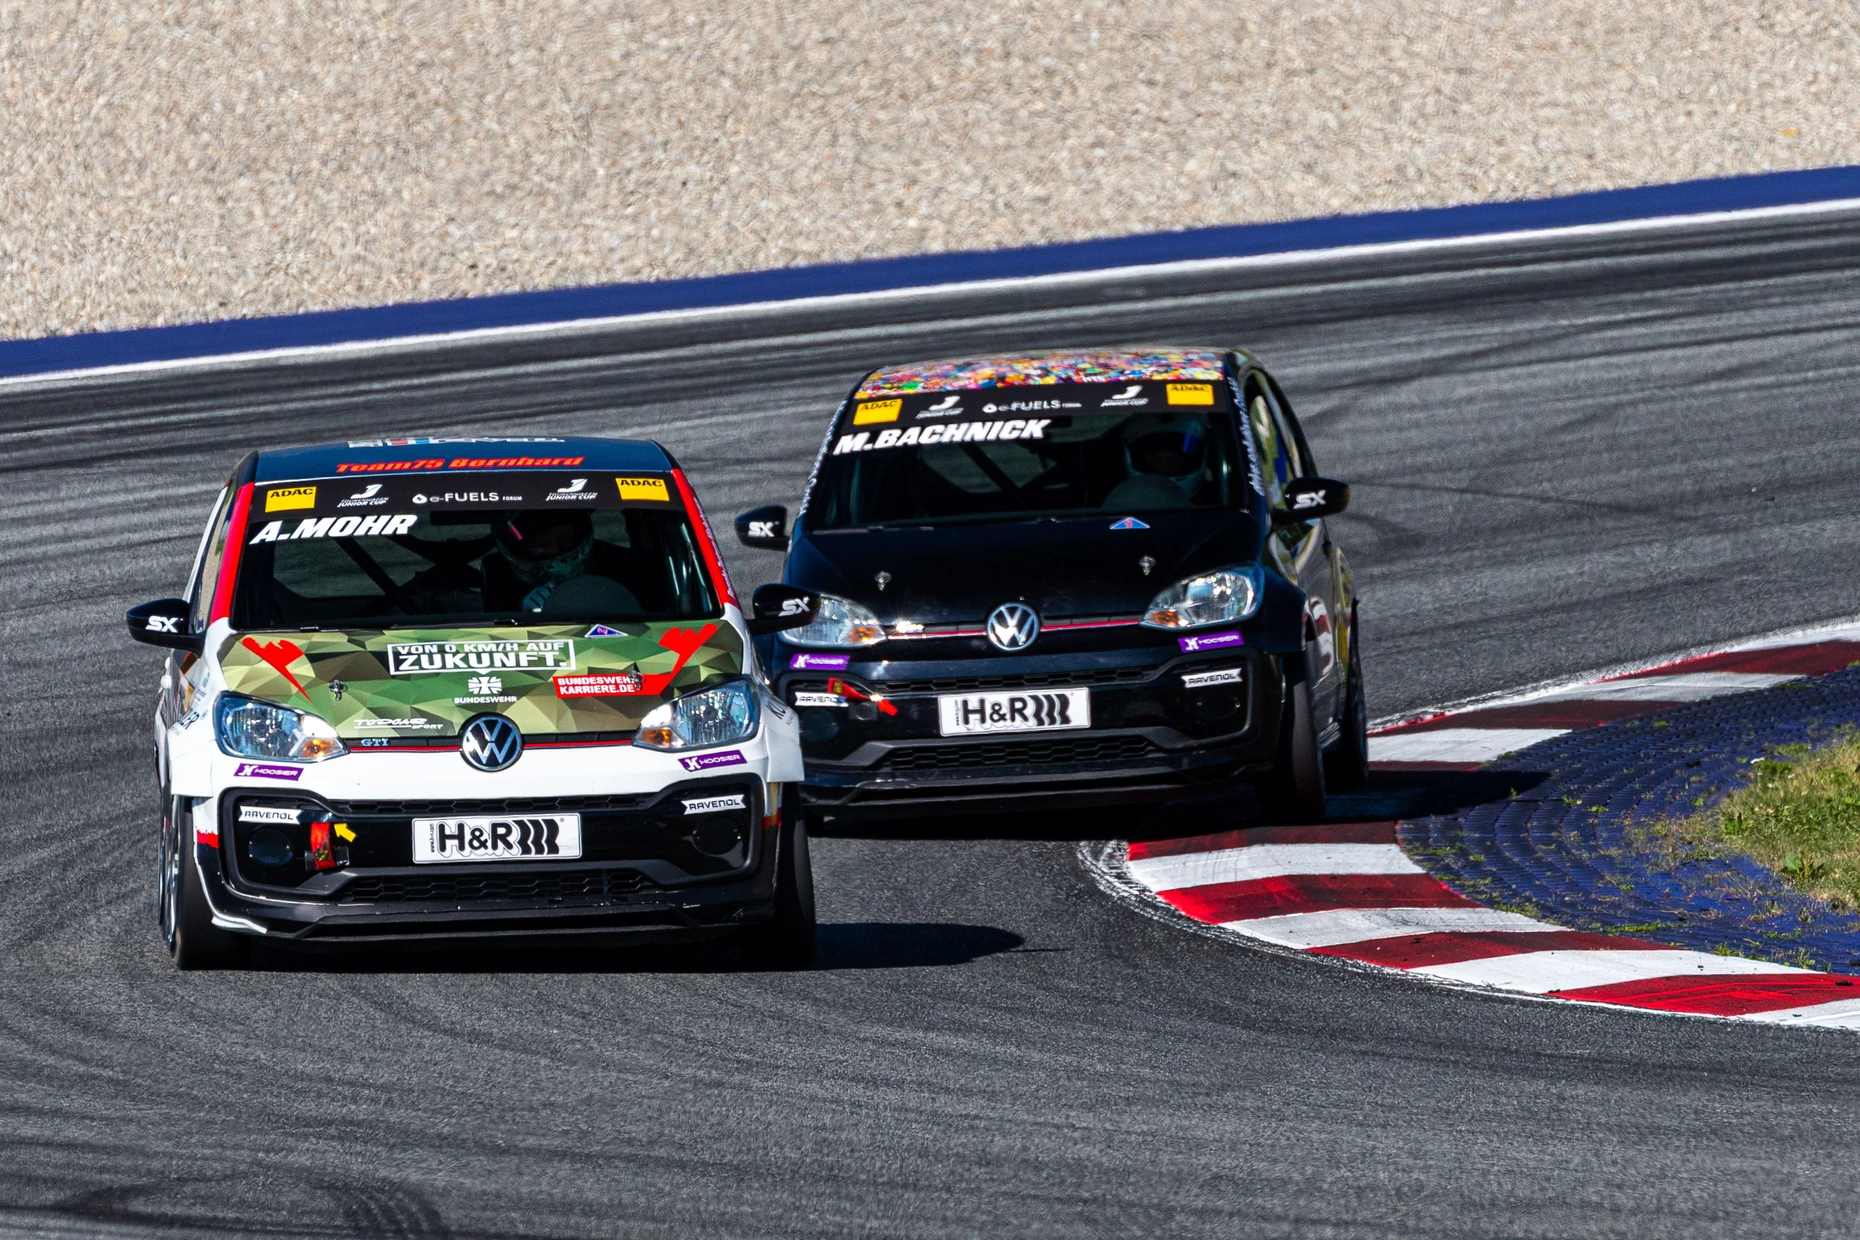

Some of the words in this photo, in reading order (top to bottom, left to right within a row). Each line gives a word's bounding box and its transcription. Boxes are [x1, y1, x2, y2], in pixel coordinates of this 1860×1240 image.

[1170, 385, 1209, 393] ADAC
[859, 400, 898, 411] ADAC
[832, 418, 1052, 455] M.BACHNICK
[336, 459, 446, 473] Team75
[449, 456, 586, 469] Bernhard
[619, 479, 662, 487] ADAC
[269, 487, 314, 498] ADAC
[429, 492, 500, 503] e-FUELS
[1292, 490, 1327, 509] SX
[249, 514, 418, 545] A.MOHR
[747, 522, 775, 537] SX
[778, 597, 811, 617] SX
[145, 615, 179, 633] SX
[397, 645, 439, 655] VON
[463, 643, 519, 652] KM/H
[526, 642, 564, 651] AUF
[398, 651, 567, 671] ZUKUNFT.
[1187, 672, 1237, 685] RAVENOL
[559, 684, 635, 695] KARRIERE.DE
[454, 695, 518, 704] BUNDESWEHR
[961, 698, 1028, 726] H&R
[353, 717, 428, 726] TOPCAR
[361, 738, 389, 747] GTI
[700, 753, 741, 765] HOOSIER
[253, 767, 298, 777] HOOSIER
[689, 798, 740, 811] RAVENOL
[244, 809, 294, 821] RAVENOL
[438, 820, 515, 853] H&R
